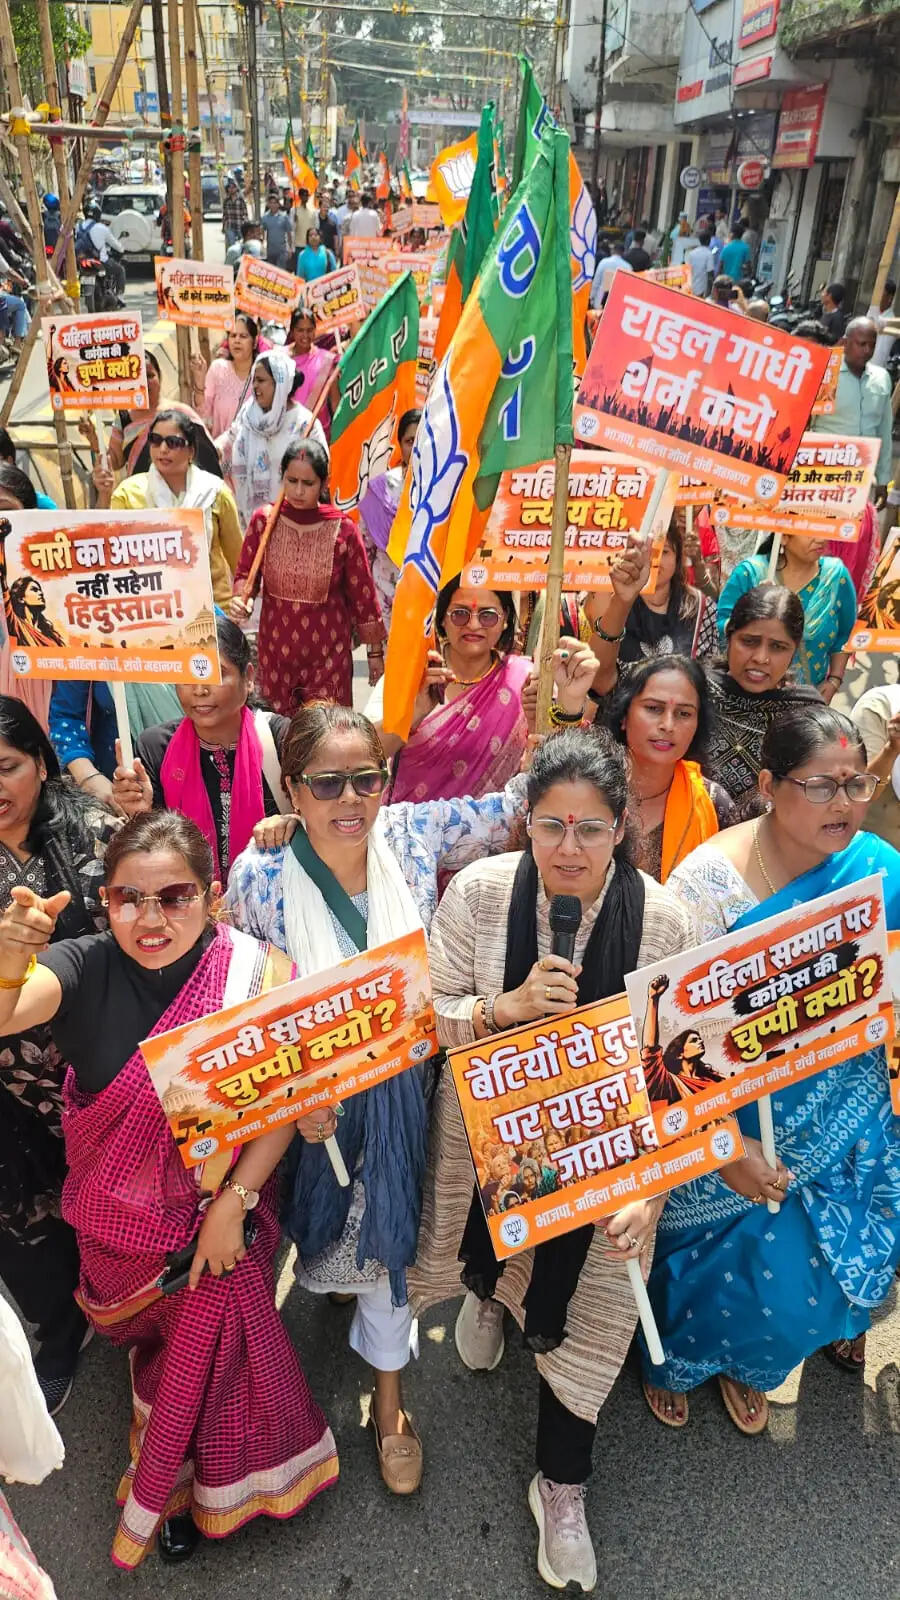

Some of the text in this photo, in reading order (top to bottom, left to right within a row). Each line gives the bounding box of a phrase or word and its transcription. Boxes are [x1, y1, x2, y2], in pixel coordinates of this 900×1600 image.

[62, 323, 137, 346] महिला सम्मान पर
[83, 343, 121, 360] कांग्रेस की
[620, 295, 725, 364] राहुल
[726, 336, 814, 395] गांधी
[78, 354, 140, 388] चुप्पी क्यों?
[621, 362, 777, 443] शर्म करो
[615, 466, 650, 500] को
[780, 486, 816, 503] अंतर
[803, 470, 821, 484] और
[824, 471, 852, 484] करनी
[854, 470, 864, 484] में
[578, 530, 605, 548] तय
[593, 495, 628, 531] दो,
[28, 530, 191, 572] नारी का अपमान,
[76, 569, 162, 599] नहीं सहेगा
[68, 655, 96, 671] महिला
[686, 900, 874, 1007] महिला सम्मान पर
[747, 952, 838, 1010] कांग्रेस की
[197, 972, 394, 1074] नारी सुरक्षा पर
[730, 957, 879, 1062] चुप्पी क्यों?
[215, 998, 398, 1107] चुप्पी क्यों?
[464, 1031, 561, 1101] बेटियों
[560, 1022, 598, 1069] से
[693, 1034, 859, 1119] भाजपा, महिला मोर्चा, रांची महानगर
[225, 1058, 403, 1145] भाजपा, महिला मोर्चा, रांची महानगर
[492, 1102, 544, 1146] पर
[543, 1070, 631, 1127] राहुल
[550, 1123, 637, 1182] जवाब
[535, 1148, 706, 1229] भाजपा, महिला मोर्चा, रांची महानगर
